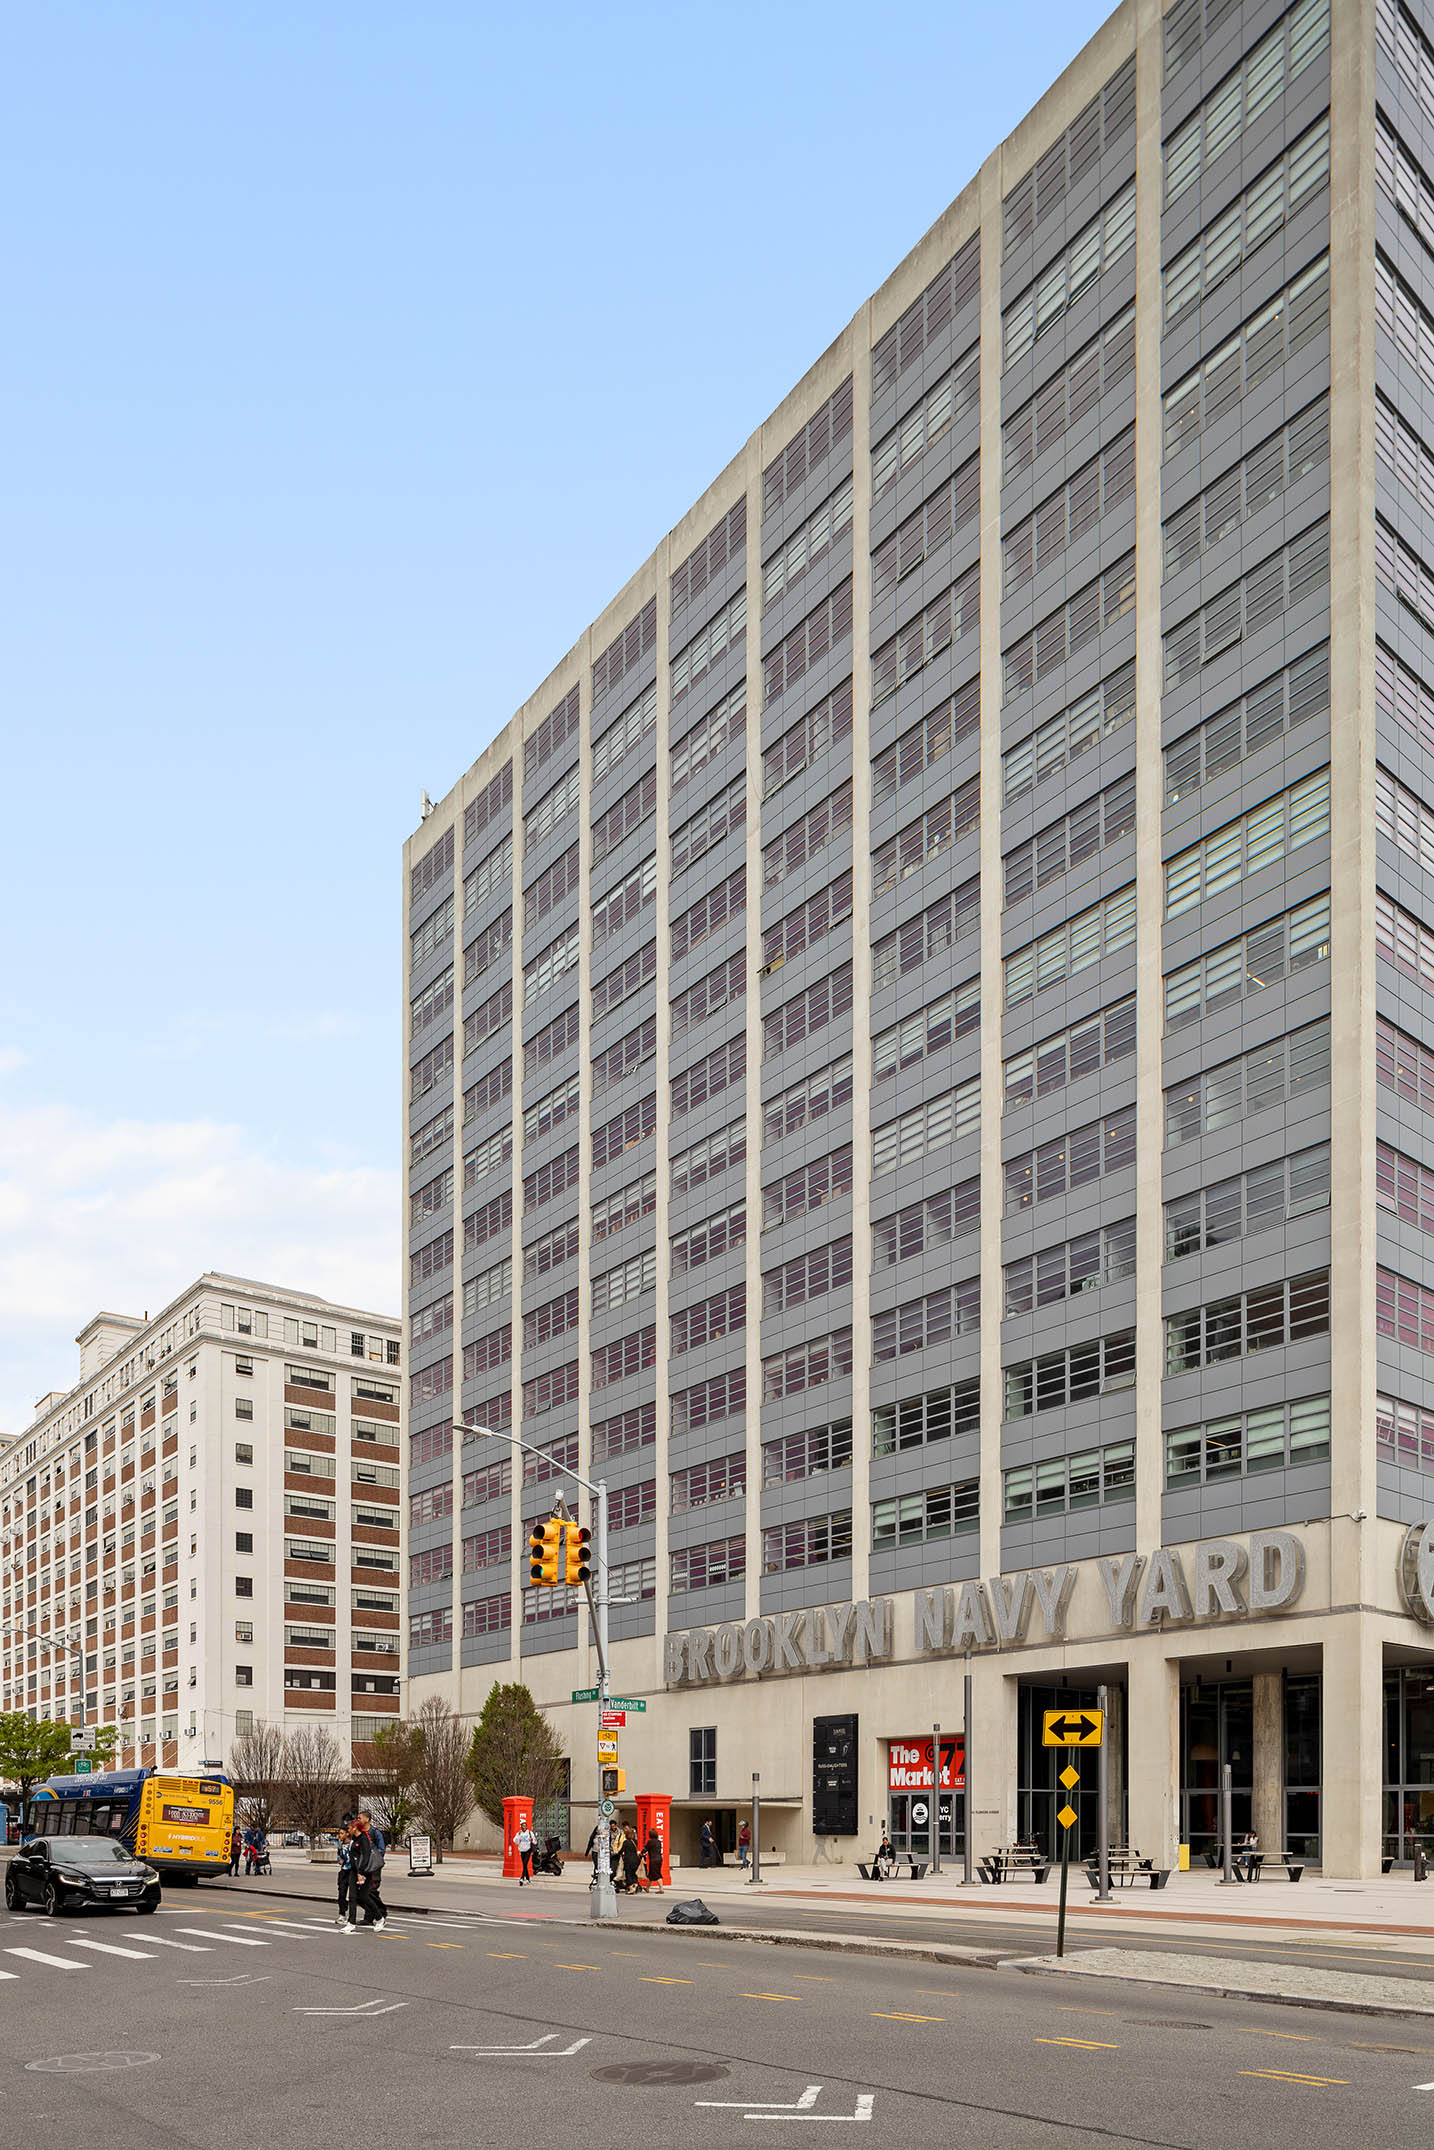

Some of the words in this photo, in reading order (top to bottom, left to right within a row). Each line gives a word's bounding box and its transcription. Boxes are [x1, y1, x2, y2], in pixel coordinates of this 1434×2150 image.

[664, 1598, 892, 1683] BROOKLYN
[913, 1565, 1078, 1650] NAVY
[1096, 1530, 1306, 1627] YARD
[611, 1699, 639, 1711] Vanderbilt
[890, 1745, 920, 1764] The
[890, 1766, 950, 1787] Market
[656, 1812, 664, 1831] EAT
